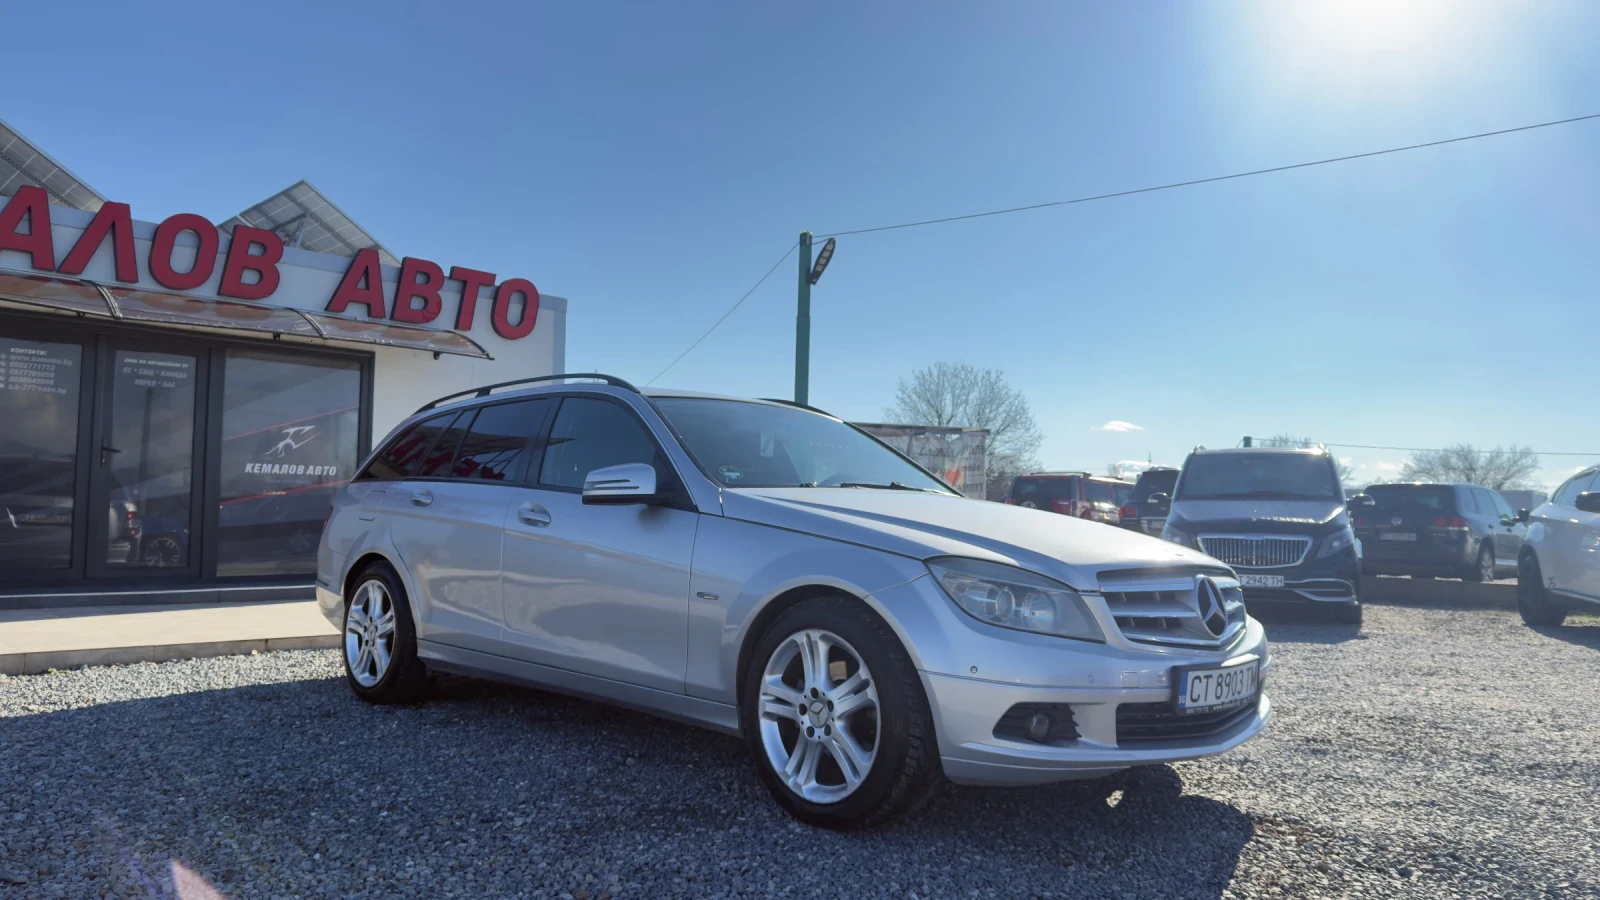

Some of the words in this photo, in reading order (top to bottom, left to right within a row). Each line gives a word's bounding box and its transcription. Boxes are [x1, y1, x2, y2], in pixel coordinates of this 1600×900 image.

[324, 248, 540, 340] АВТО
[244, 463, 305, 475] КЕМАЛОВ
[306, 465, 337, 476] АВТО
[1245, 575, 1269, 586] 2942
[1270, 576, 1283, 586] TH
[1190, 674, 1213, 703] CT
[1215, 669, 1244, 700] 8903
